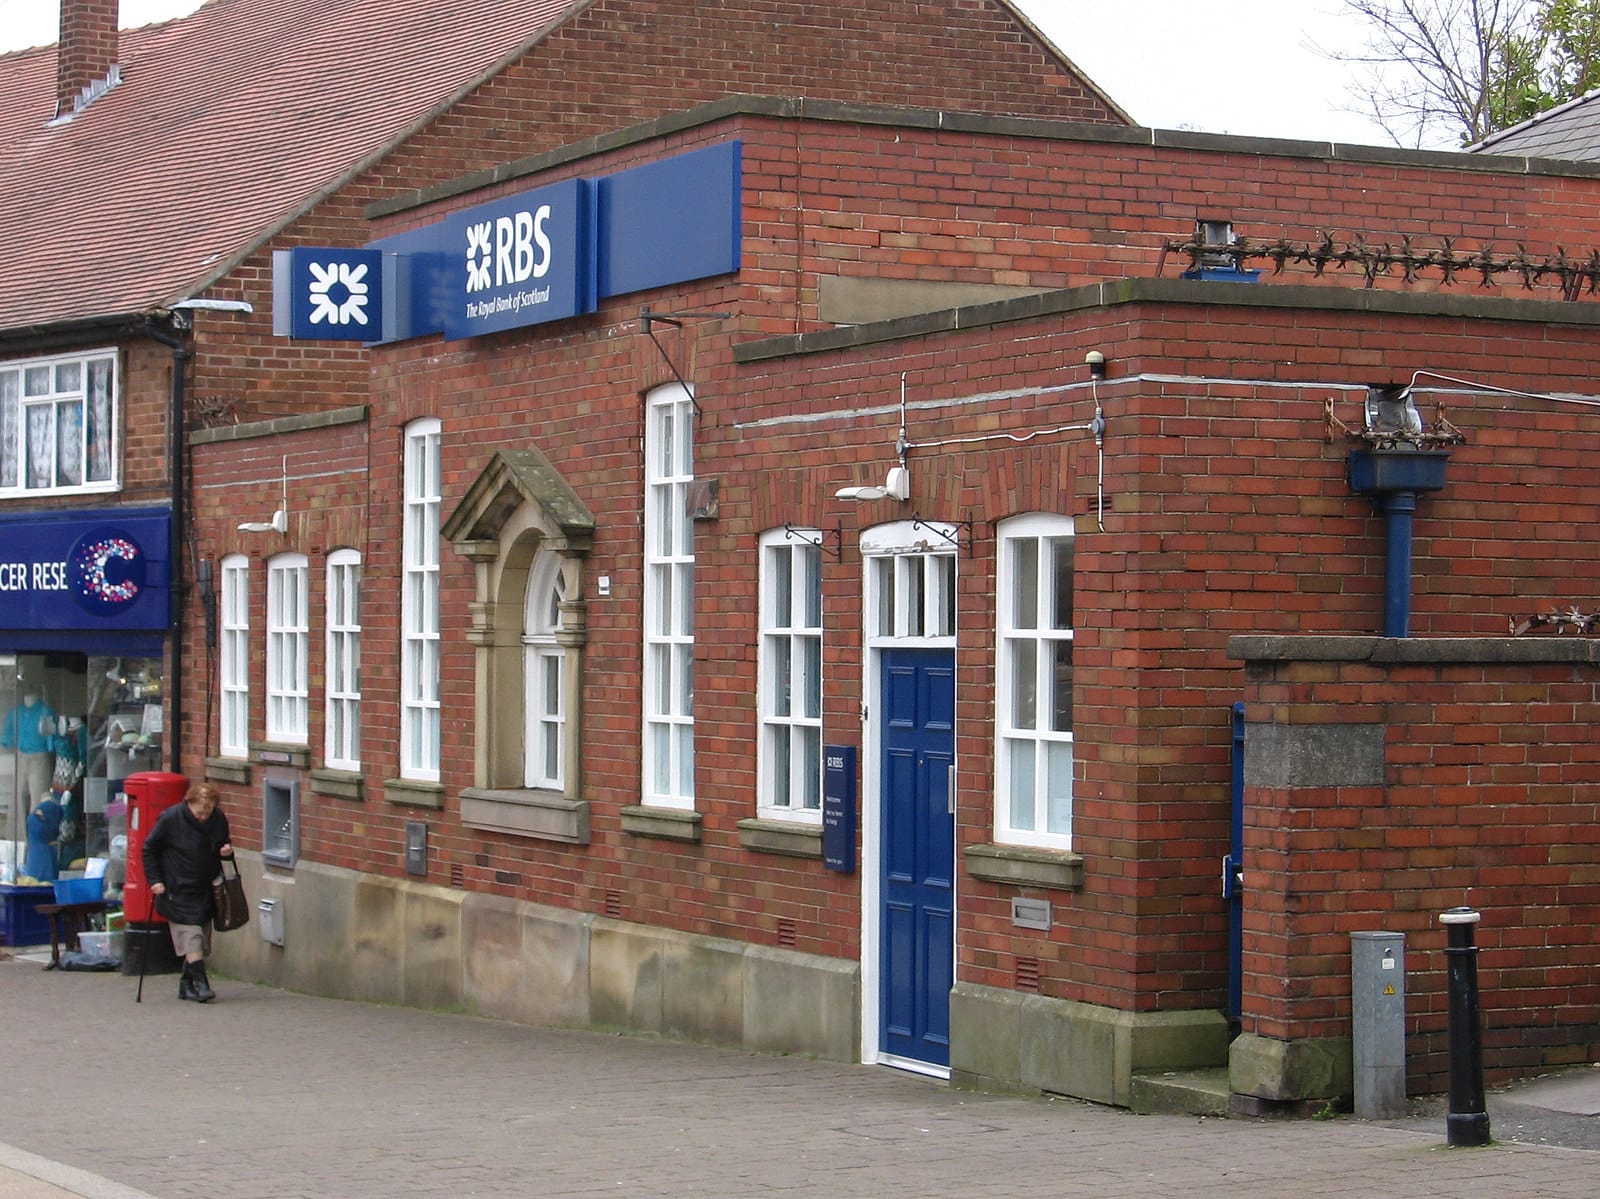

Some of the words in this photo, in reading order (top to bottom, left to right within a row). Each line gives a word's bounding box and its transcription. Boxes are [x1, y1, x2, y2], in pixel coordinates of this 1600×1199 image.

[496, 205, 551, 287] RBS
[466, 303, 478, 319] The
[478, 297, 496, 319] Royal
[496, 294, 512, 312] Bank
[512, 291, 521, 313] of
[520, 285, 550, 307] Scotland
[0, 563, 27, 590] CER
[33, 562, 69, 590] RESE
